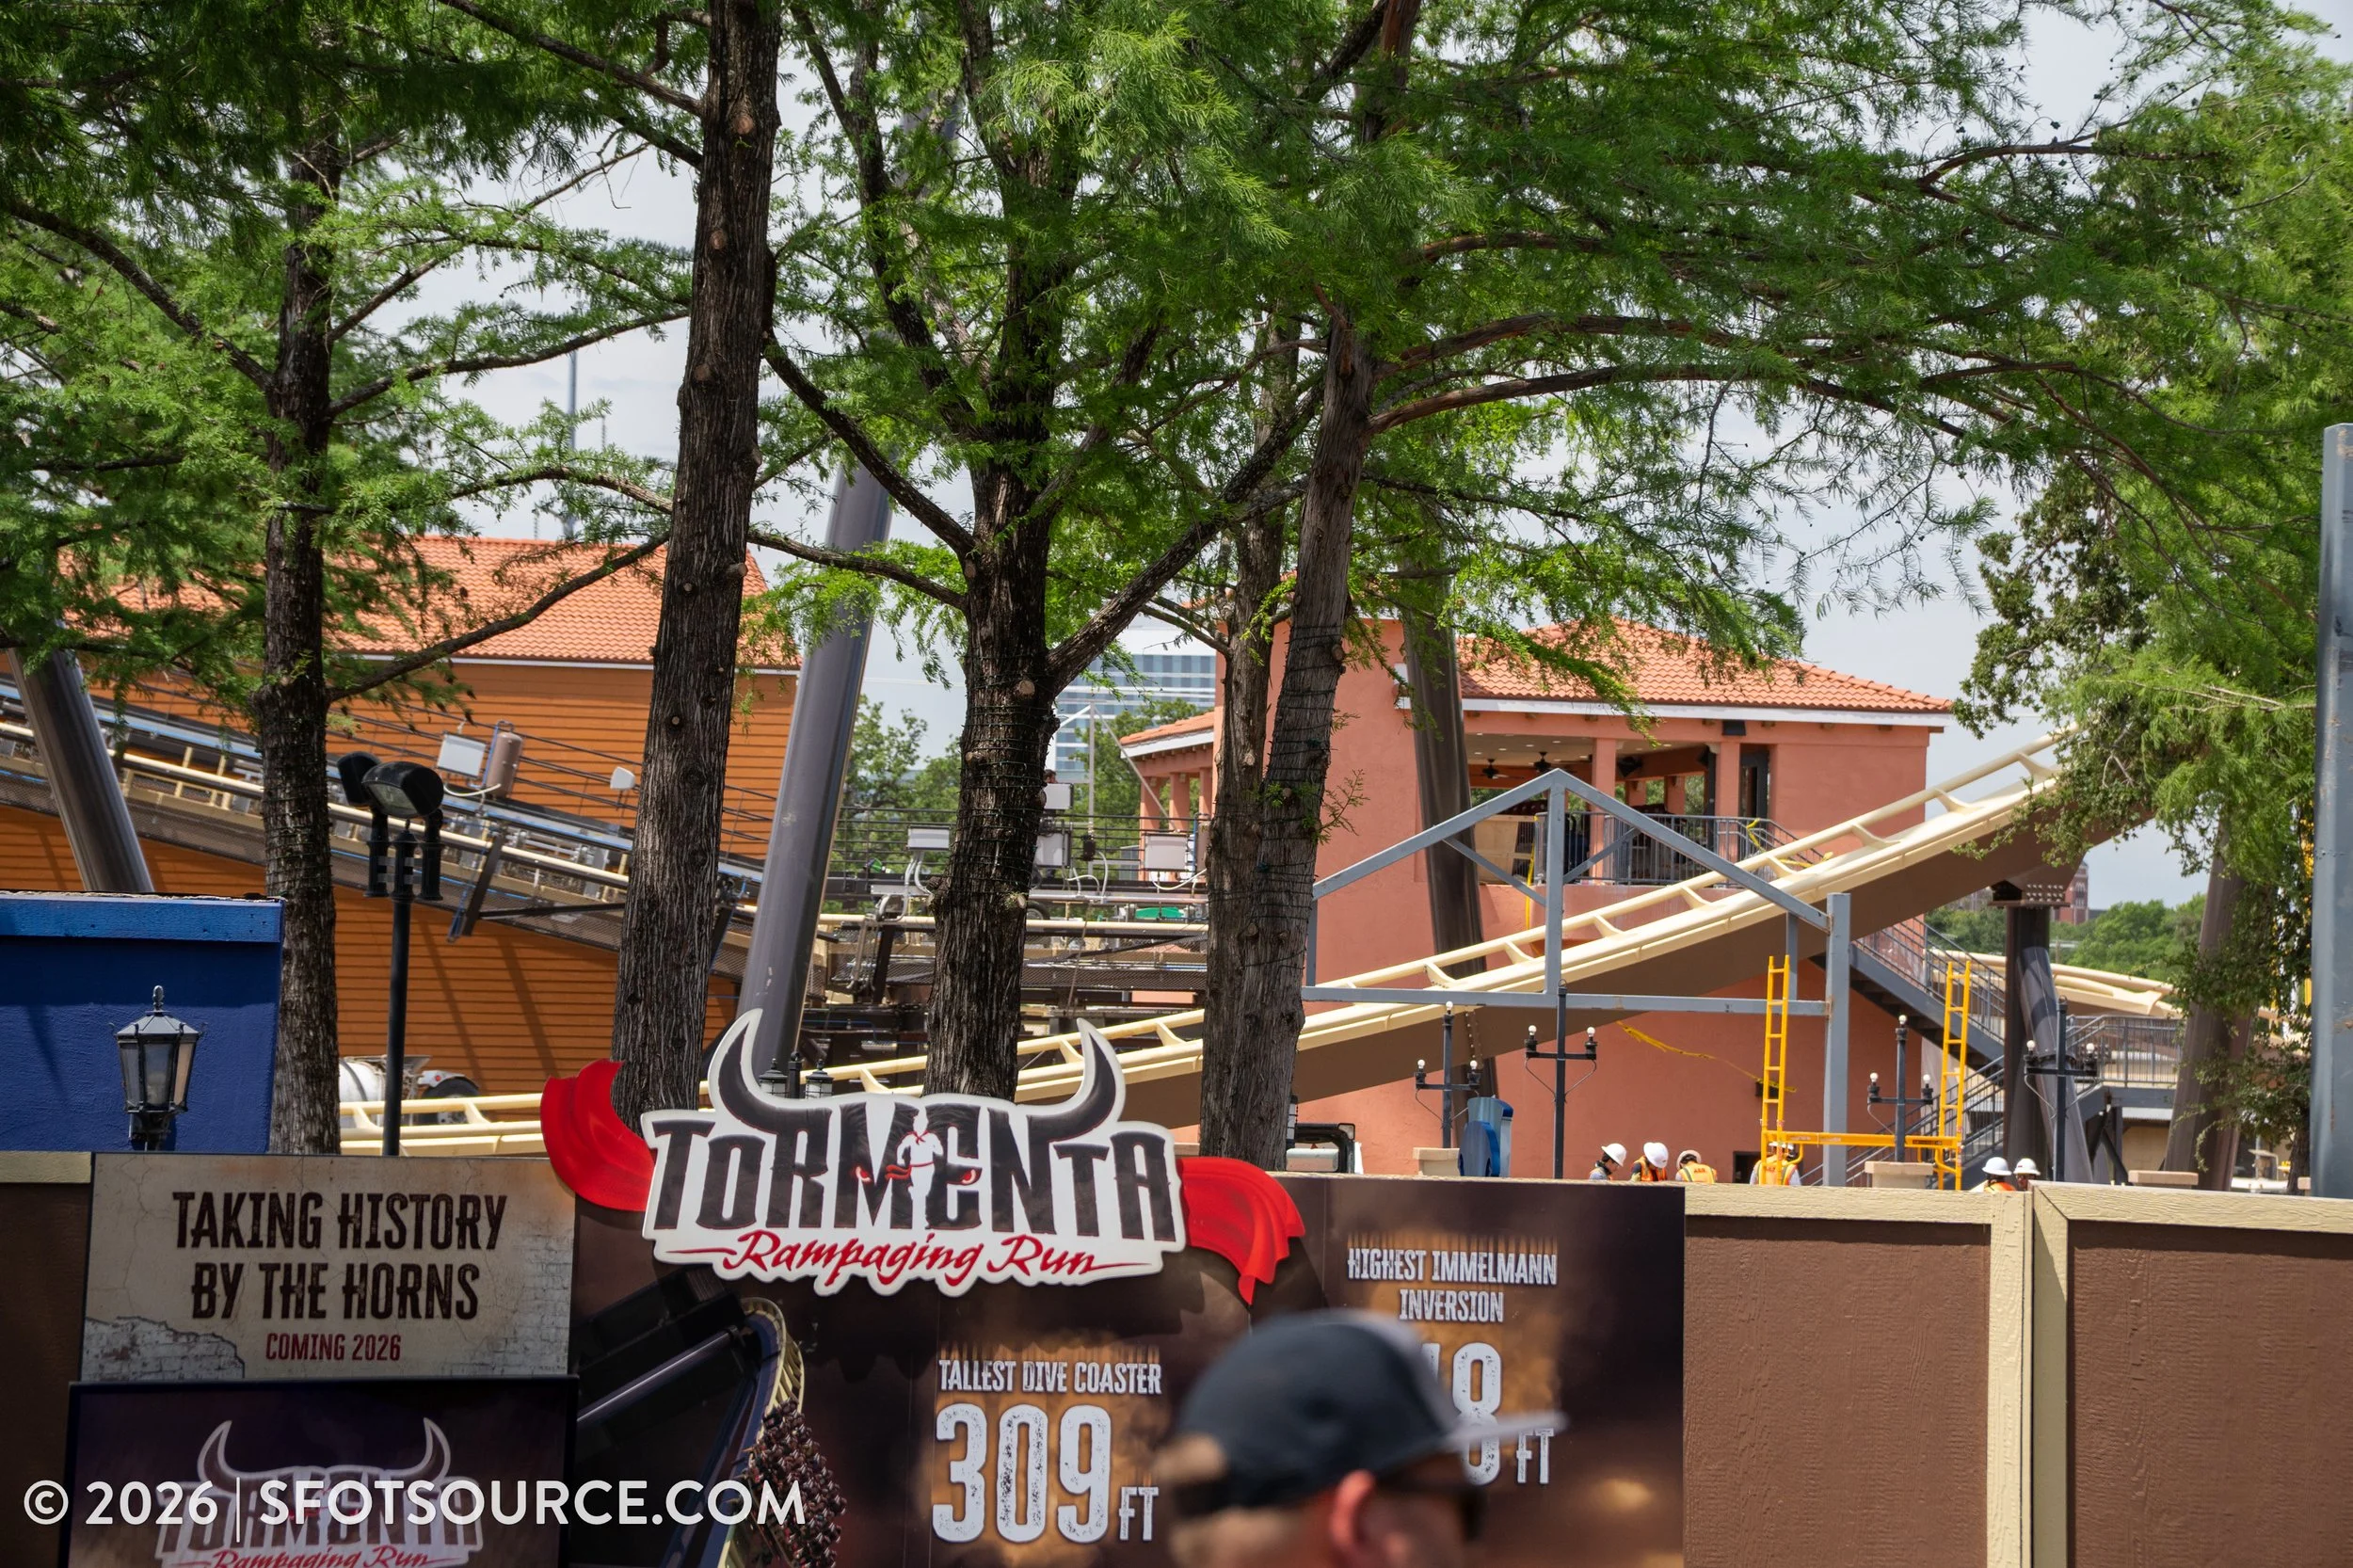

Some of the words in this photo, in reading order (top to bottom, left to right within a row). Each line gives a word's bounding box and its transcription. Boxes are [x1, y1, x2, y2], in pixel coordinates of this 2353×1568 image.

[651, 1101, 1176, 1242] TORMENTA
[172, 1192, 324, 1249] TAKING
[337, 1192, 508, 1250] HISTORY
[723, 1229, 984, 1287] Rampaging
[987, 1234, 1106, 1276] Run
[1348, 1248, 1427, 1280] HIGHEST
[1432, 1250, 1558, 1285] IMMELMANN
[191, 1262, 245, 1320] BY
[258, 1262, 328, 1320] THE
[342, 1262, 480, 1320] HORNS
[1400, 1288, 1504, 1322] INVERSION
[265, 1333, 345, 1361] COMING
[352, 1334, 402, 1361] 2026
[938, 1359, 1016, 1391] TALLEST
[1022, 1361, 1067, 1392] DIVE
[1074, 1362, 1162, 1395] COASTER
[933, 1403, 1111, 1543] 309
[1118, 1486, 1159, 1541] FT
[1515, 1426, 1555, 1484] FT
